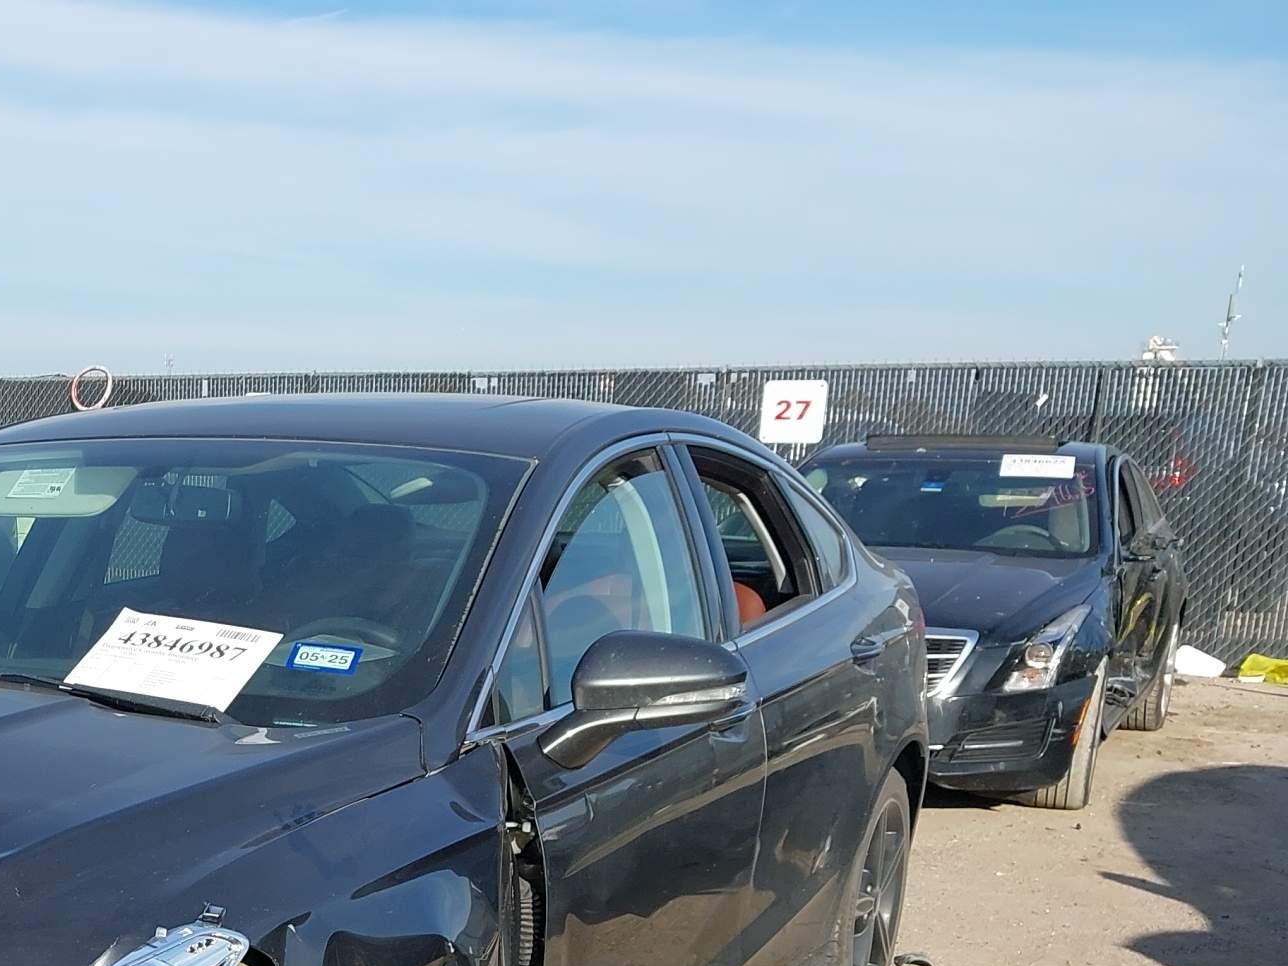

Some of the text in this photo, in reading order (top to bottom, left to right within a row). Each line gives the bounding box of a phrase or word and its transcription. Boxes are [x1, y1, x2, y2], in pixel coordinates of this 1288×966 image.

[774, 399, 812, 421] 27
[117, 630, 249, 662] 43846987
[298, 651, 350, 665] 05 25
